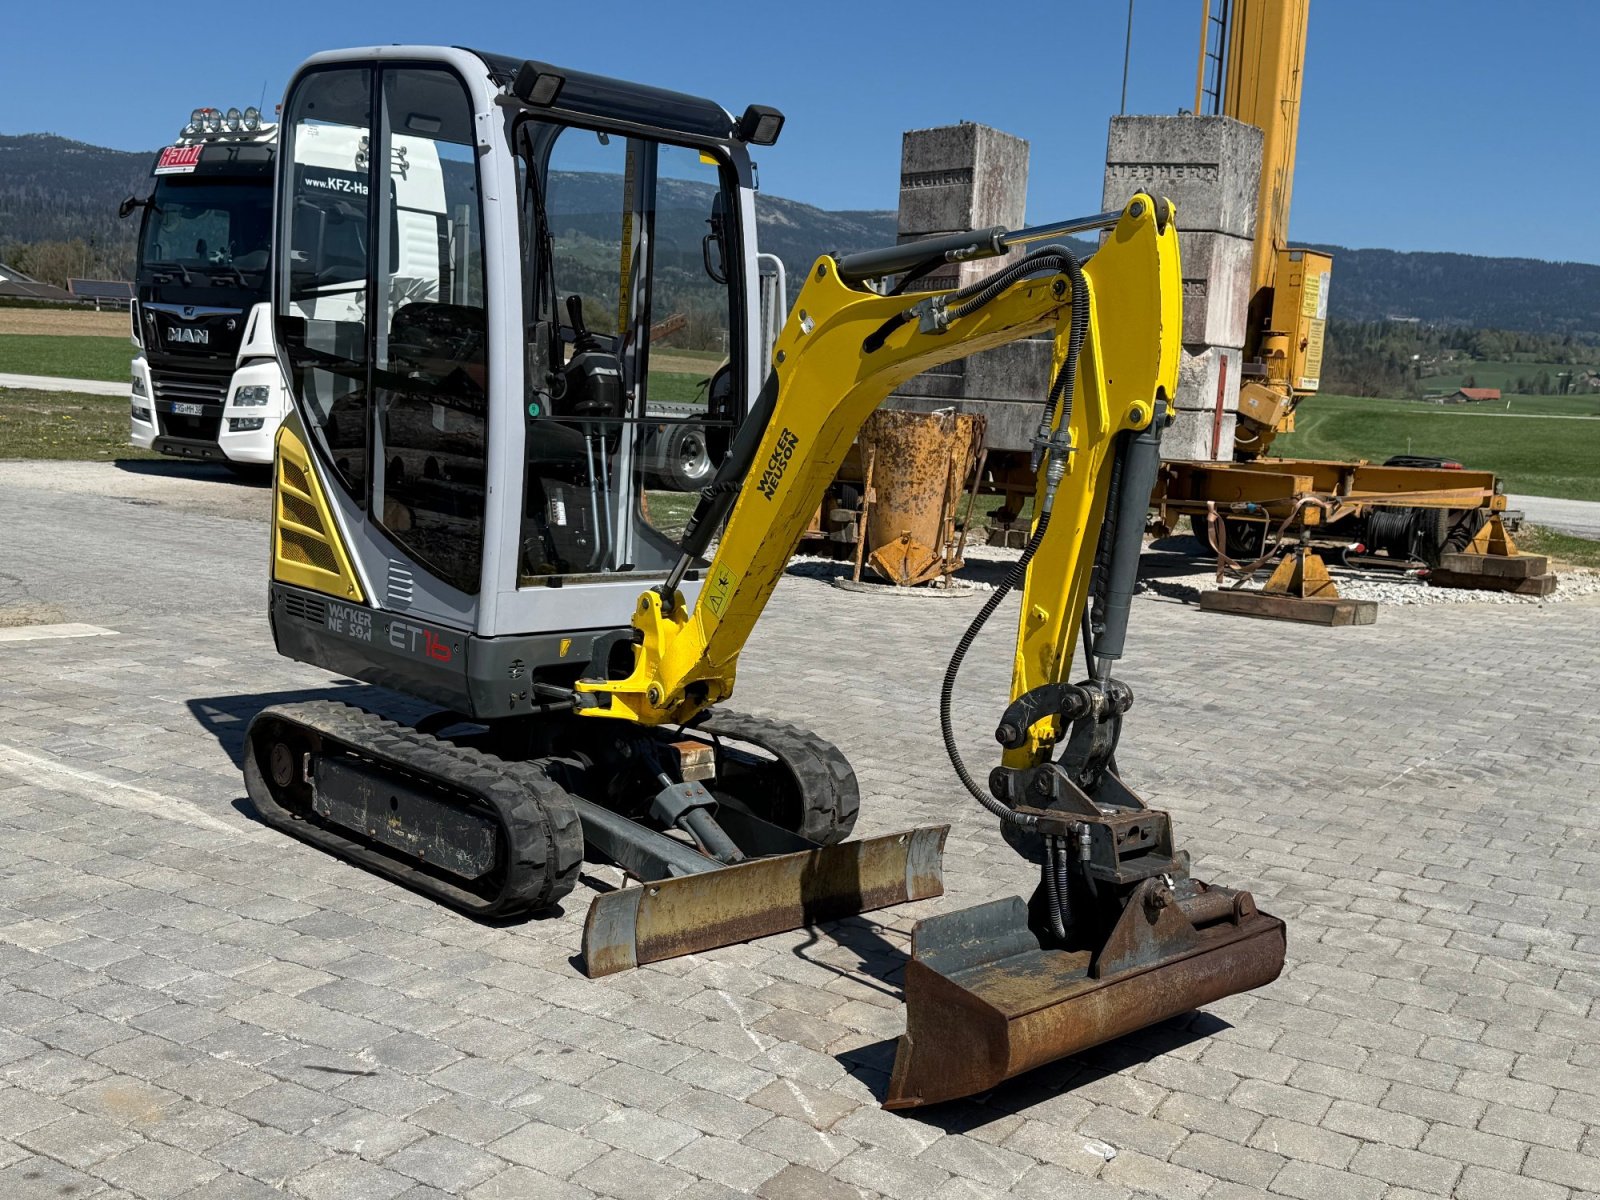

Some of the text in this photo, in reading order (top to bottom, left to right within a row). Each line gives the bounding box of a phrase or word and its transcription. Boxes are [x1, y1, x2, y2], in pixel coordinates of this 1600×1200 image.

[167, 326, 208, 344] MAN
[757, 427, 791, 491] WACKER
[764, 432, 799, 502] NEUSON
[389, 621, 452, 662] ET16
